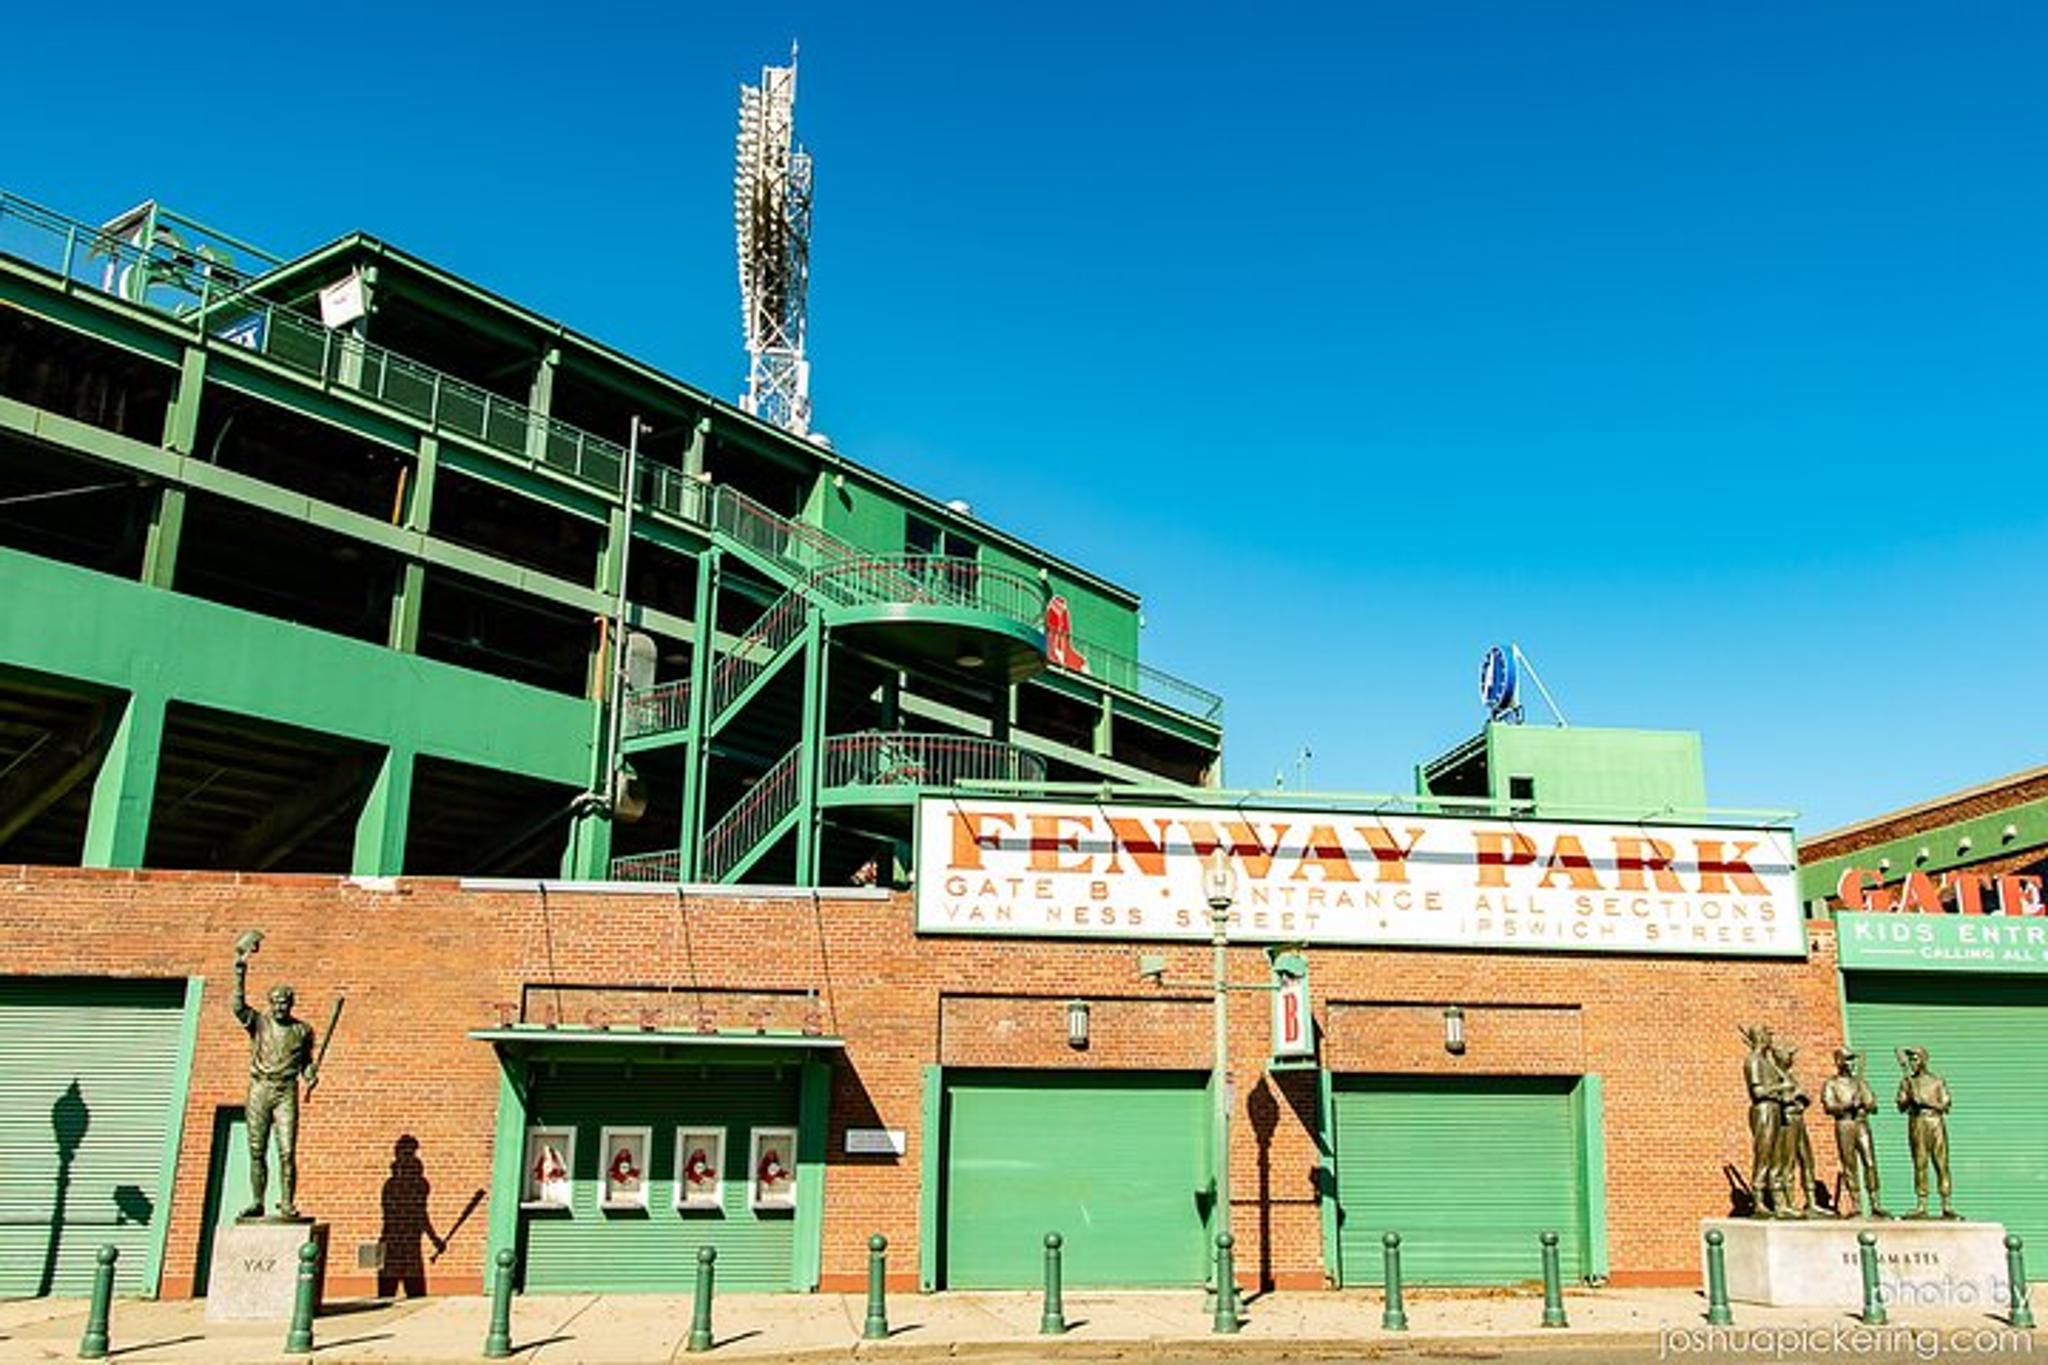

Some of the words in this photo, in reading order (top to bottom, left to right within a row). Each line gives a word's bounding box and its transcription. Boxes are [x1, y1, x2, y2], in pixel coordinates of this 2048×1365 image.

[946, 811, 1426, 884] FENWAY
[1472, 831, 1772, 896] PARK
[945, 877, 1053, 900] GATE
[1090, 881, 1109, 900] B
[1231, 886, 1443, 910] NTRANCE
[1476, 895, 1545, 914] ALL
[1575, 896, 1777, 922] SECTIONS
[1838, 868, 2044, 916] GATE
[945, 904, 1012, 922] VAN
[1046, 907, 1143, 926] NESS
[1460, 917, 1616, 939] IPSWICH
[1646, 923, 1778, 943] STREET
[1855, 922, 1935, 943] KIDS
[1283, 992, 1299, 1042] B
[243, 1259, 277, 1273] YAZ
[1843, 1253, 1939, 1265] TEMATES
